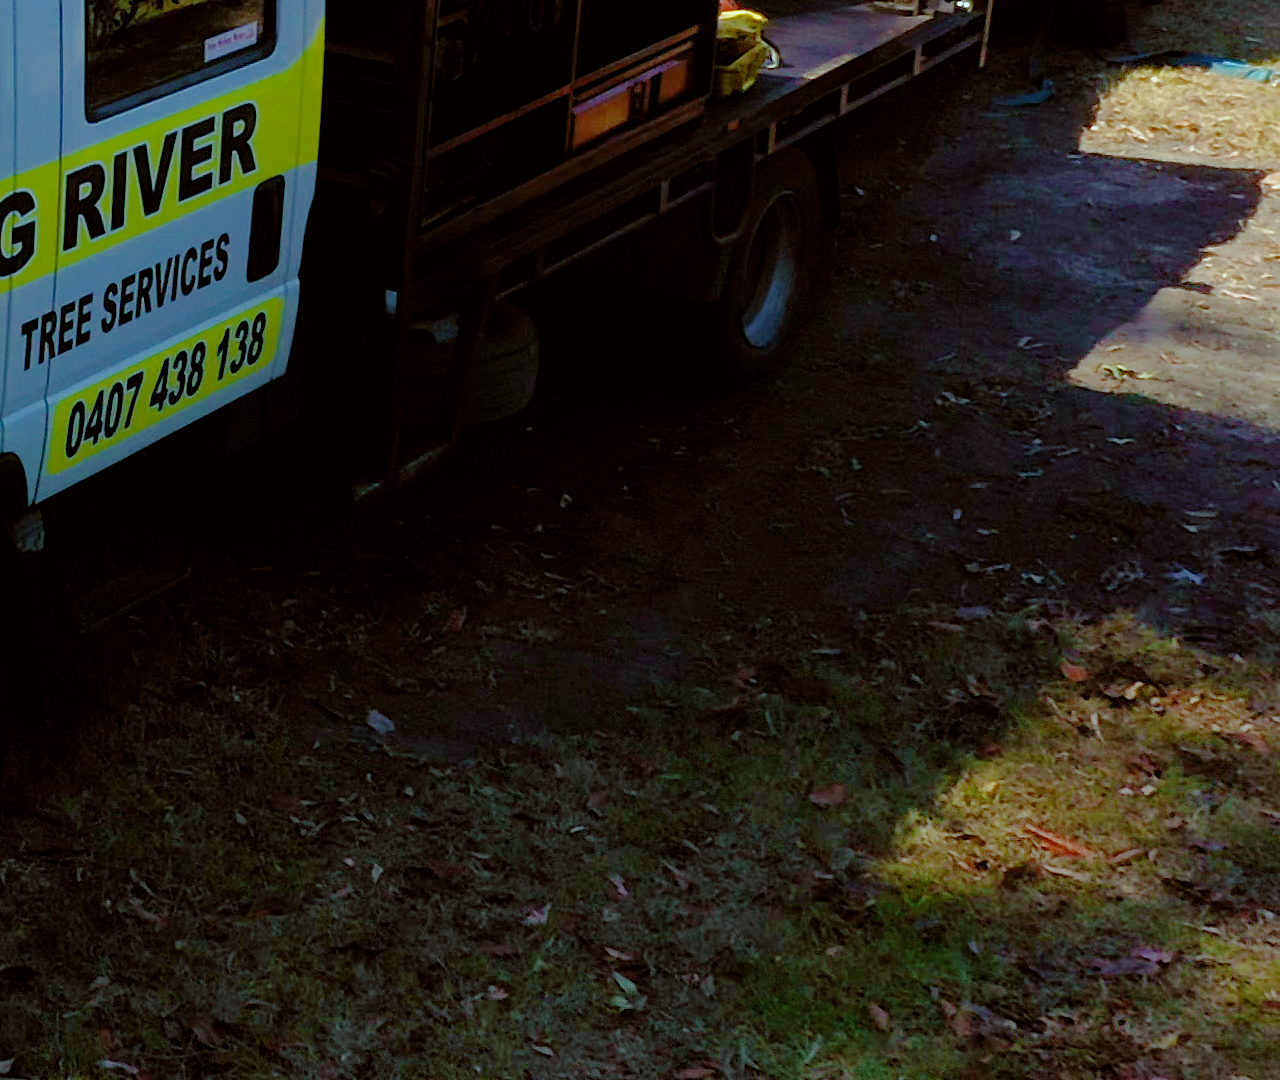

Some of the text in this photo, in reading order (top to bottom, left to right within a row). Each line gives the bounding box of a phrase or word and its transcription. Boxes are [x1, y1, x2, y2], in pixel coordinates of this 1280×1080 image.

[62, 102, 258, 252] RIVER
[20, 233, 231, 372] TREE SERVICES
[64, 312, 267, 459] 0407 438 138
